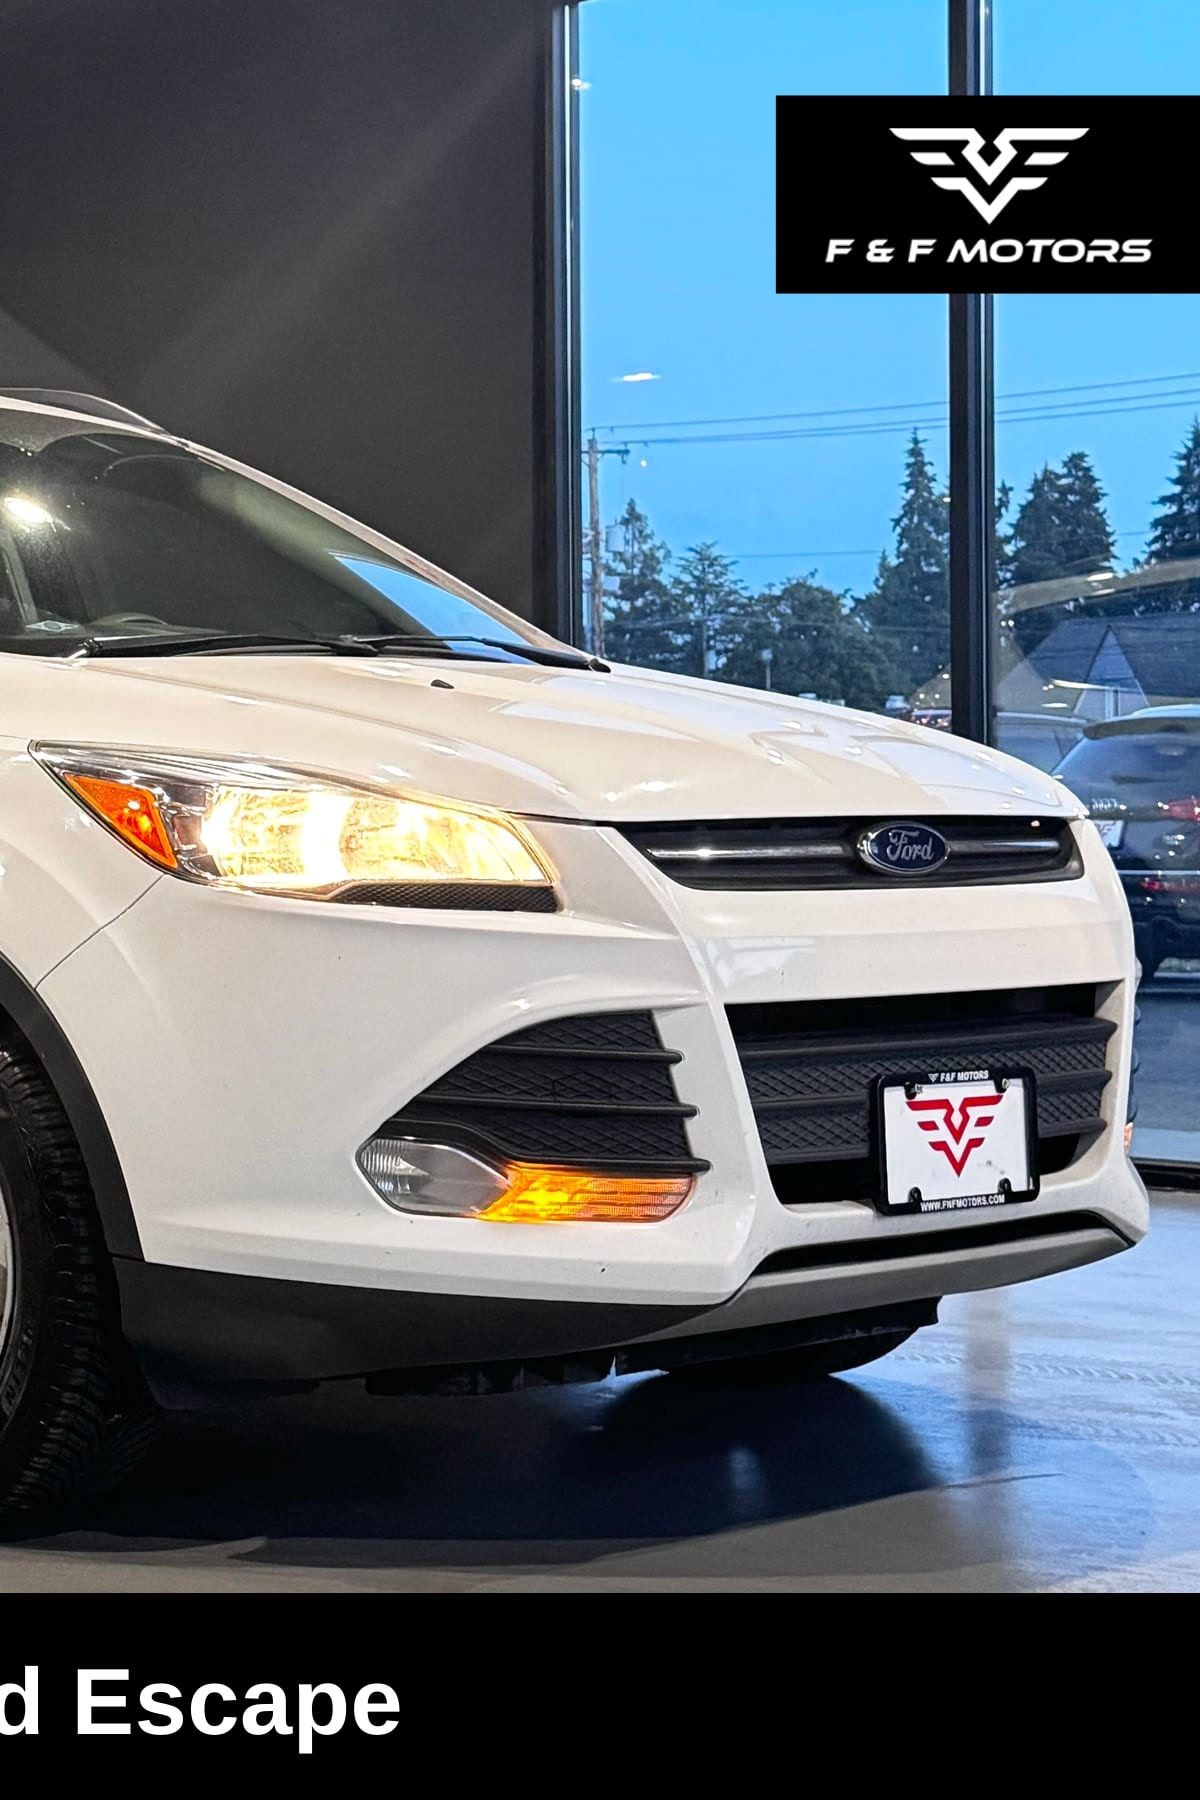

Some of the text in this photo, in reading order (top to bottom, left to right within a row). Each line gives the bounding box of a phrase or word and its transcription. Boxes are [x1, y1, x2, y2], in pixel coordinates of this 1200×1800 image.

[886, 829, 935, 861] Ford
[940, 1070, 989, 1082] F&F MOTORS
[920, 1194, 1005, 1212] WWW.FNFMOTORS.COM
